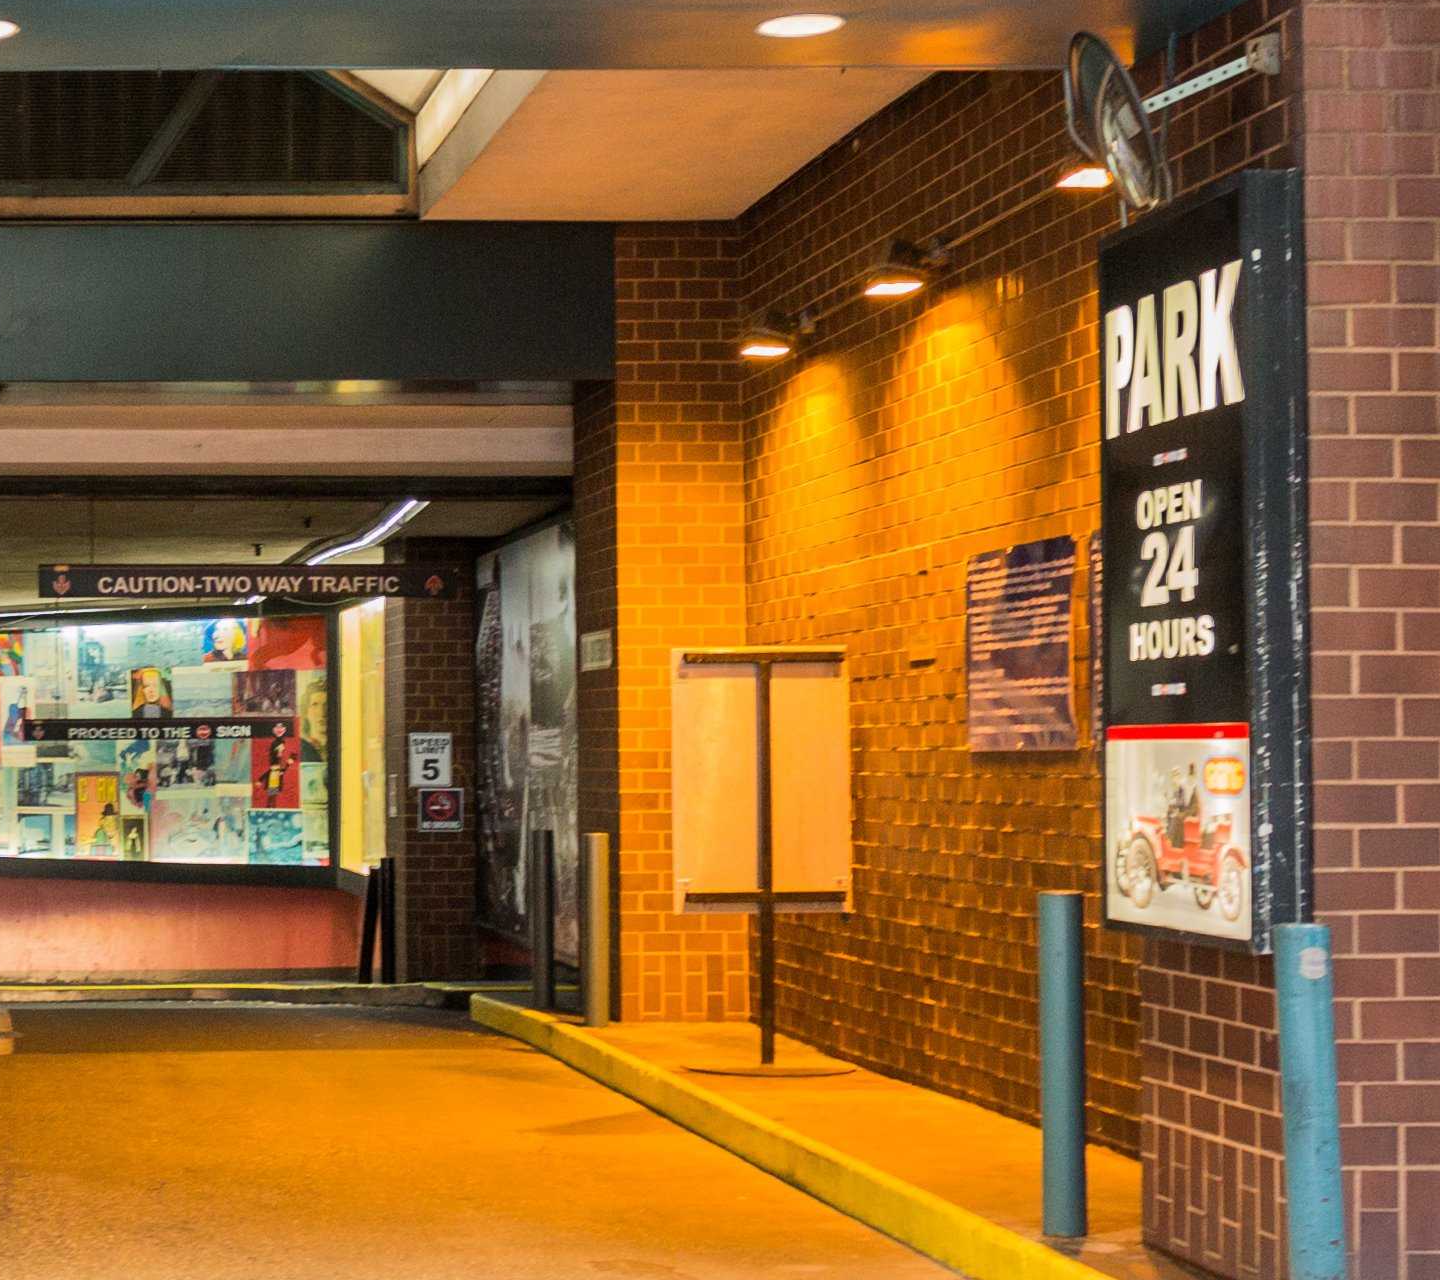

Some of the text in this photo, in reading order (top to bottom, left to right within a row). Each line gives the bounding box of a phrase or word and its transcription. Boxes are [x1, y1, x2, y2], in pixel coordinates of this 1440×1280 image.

[1105, 258, 1246, 441] PARK
[1136, 478, 1204, 531] OPEN
[1140, 524, 1200, 608] 24
[97, 575, 401, 595] CAUTION-TWO WAY TRAFFIC
[1129, 614, 1216, 662] HOURS
[67, 727, 138, 740] PROCEED
[141, 727, 161, 739] TO
[163, 726, 192, 739] THE
[216, 724, 252, 738] SIGN
[412, 738, 450, 747] SPEED
[415, 746, 446, 755] LIMIT
[422, 758, 440, 780] 5
